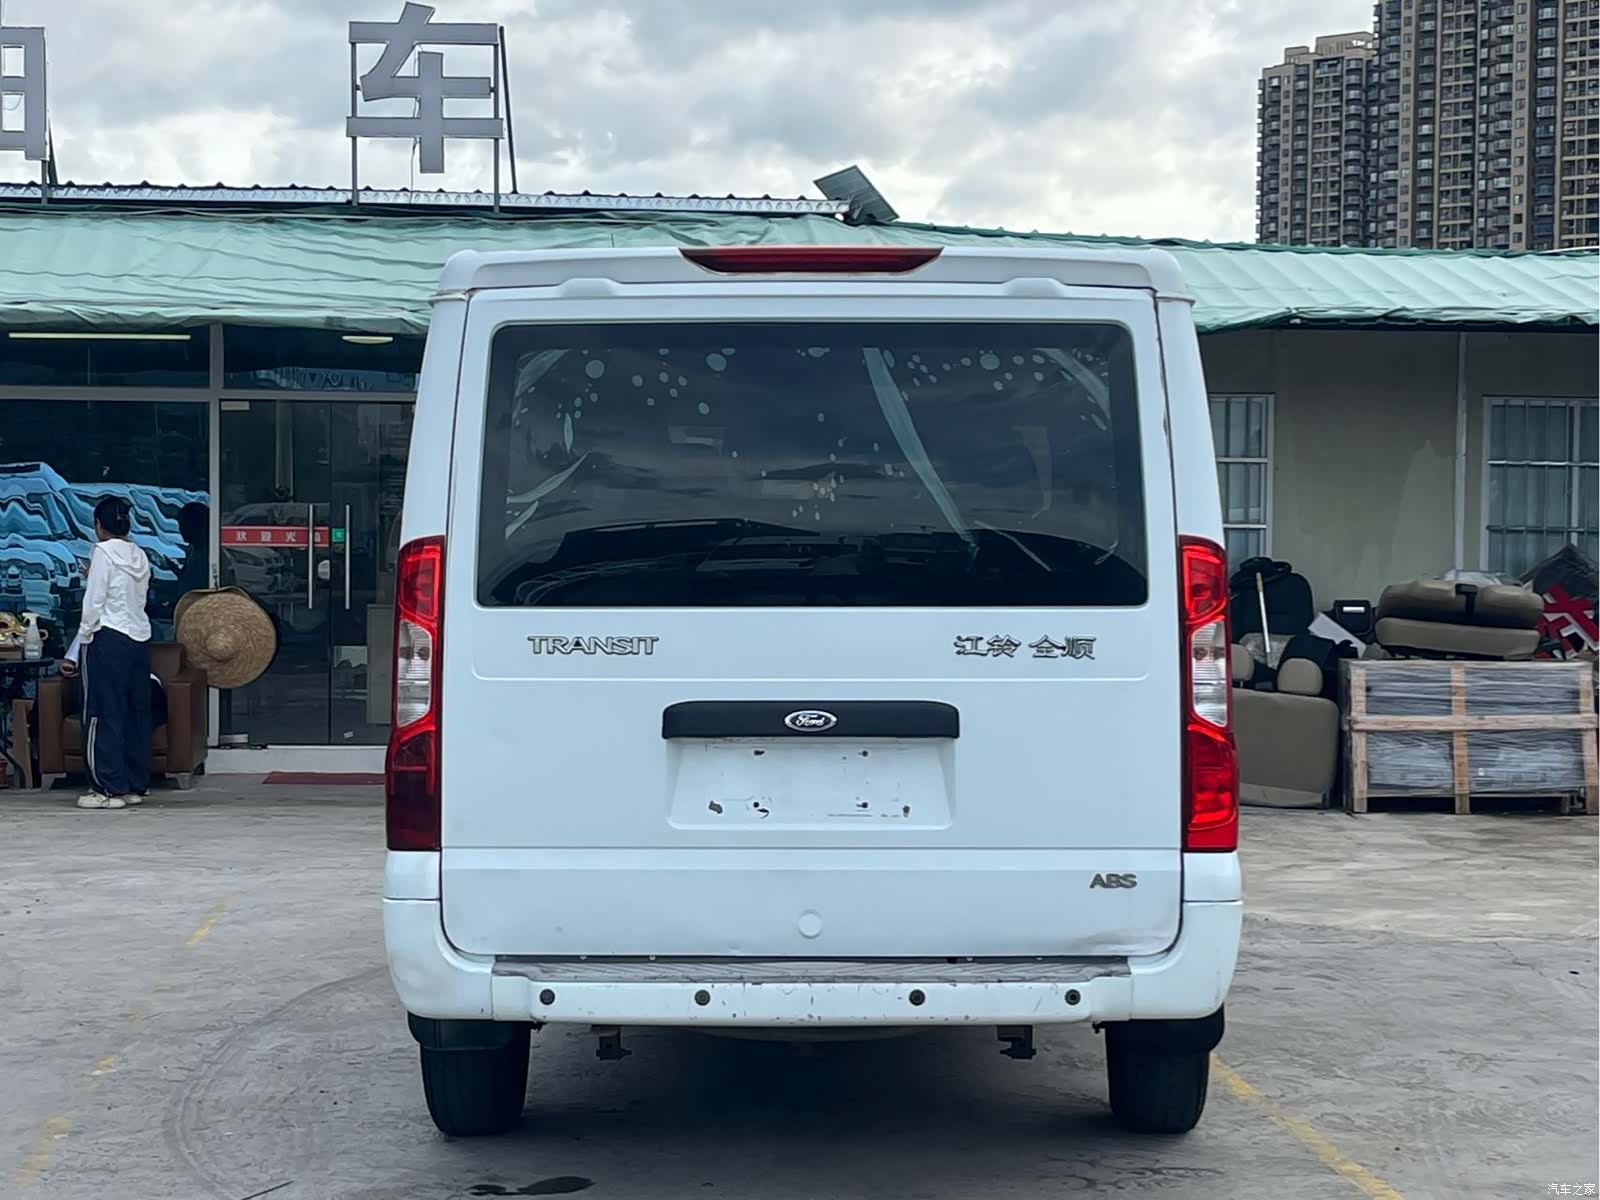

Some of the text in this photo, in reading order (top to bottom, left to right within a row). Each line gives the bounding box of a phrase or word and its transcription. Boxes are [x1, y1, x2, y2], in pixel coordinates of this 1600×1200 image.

[347, 3, 503, 174] 车
[527, 635, 660, 655] TRANSIT
[953, 634, 1097, 660] 江铃 全顺
[795, 713, 825, 727] Ford
[1089, 873, 1137, 889] ABS
